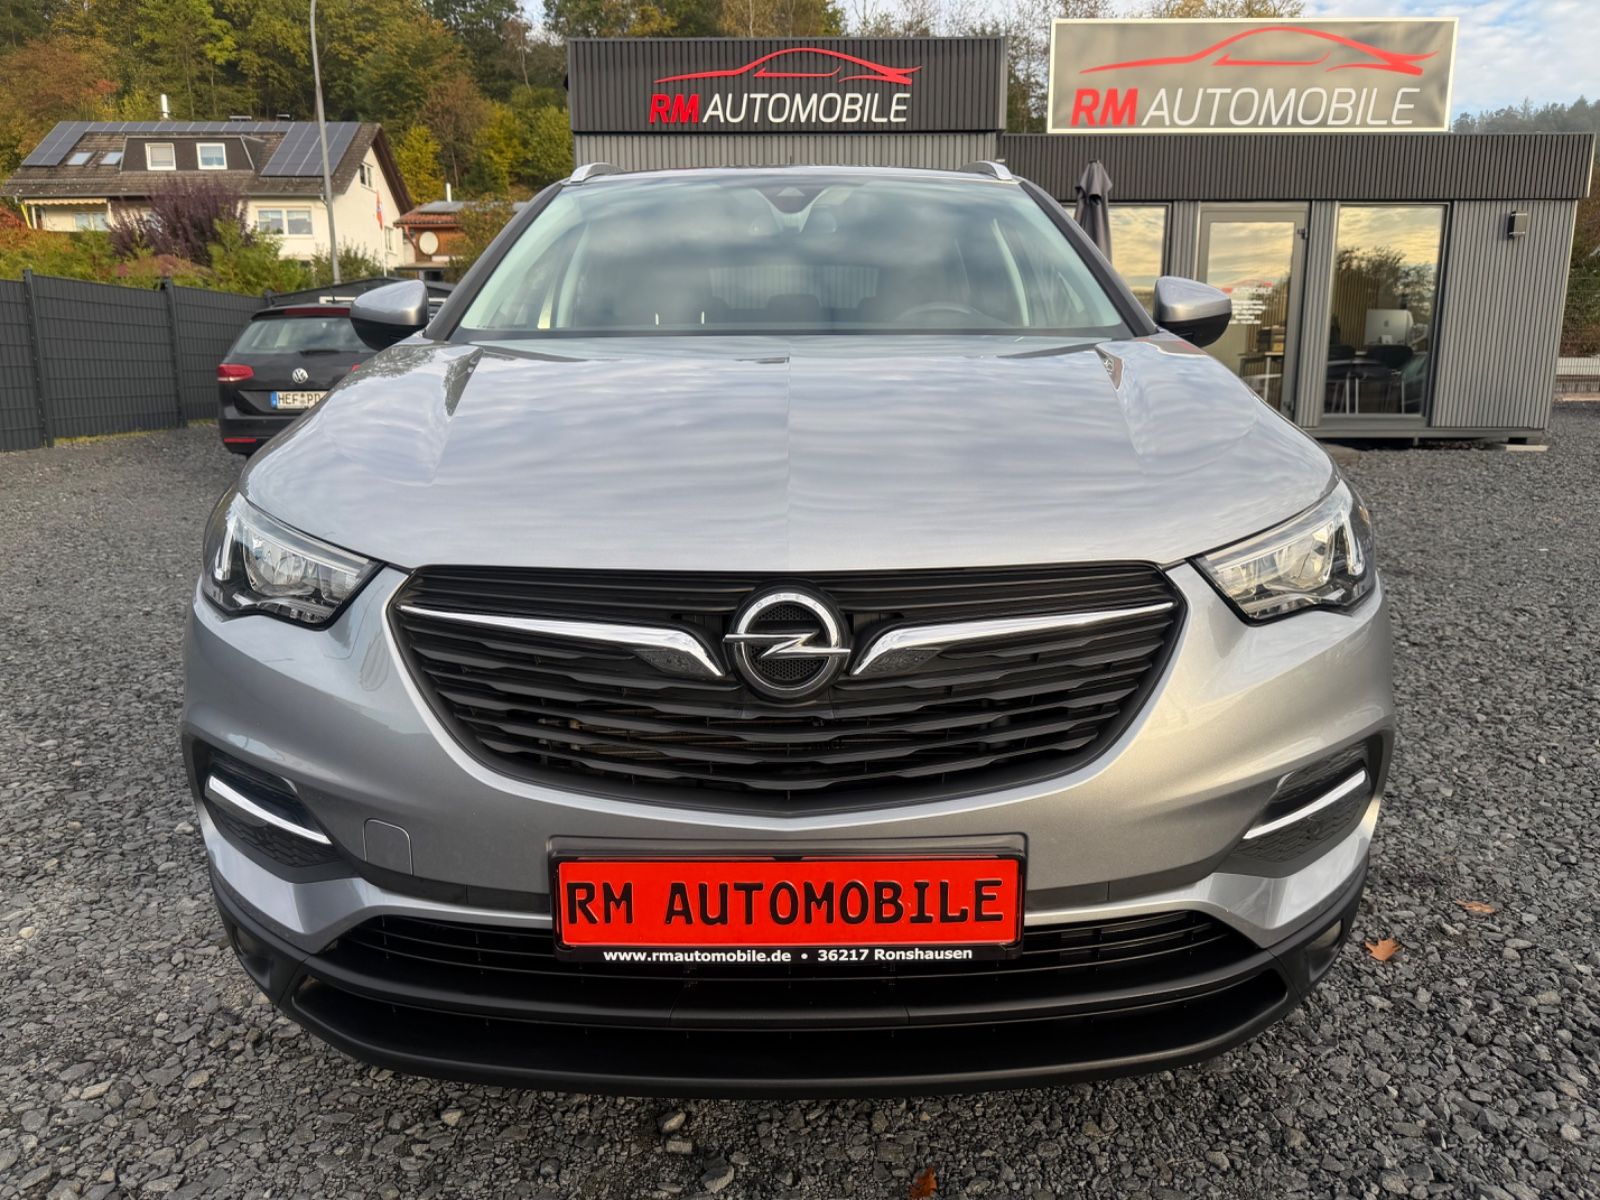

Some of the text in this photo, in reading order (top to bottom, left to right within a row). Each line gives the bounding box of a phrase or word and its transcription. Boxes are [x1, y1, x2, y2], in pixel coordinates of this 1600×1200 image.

[648, 92, 912, 124] RM AUTOMOBILE
[1070, 87, 1421, 127] RM AUTOMOBILE
[278, 393, 298, 405] HEF
[566, 879, 1004, 926] RM AUTOMOBILE
[603, 947, 973, 963] www.rmautomobile.de 36217 Ronshausen
